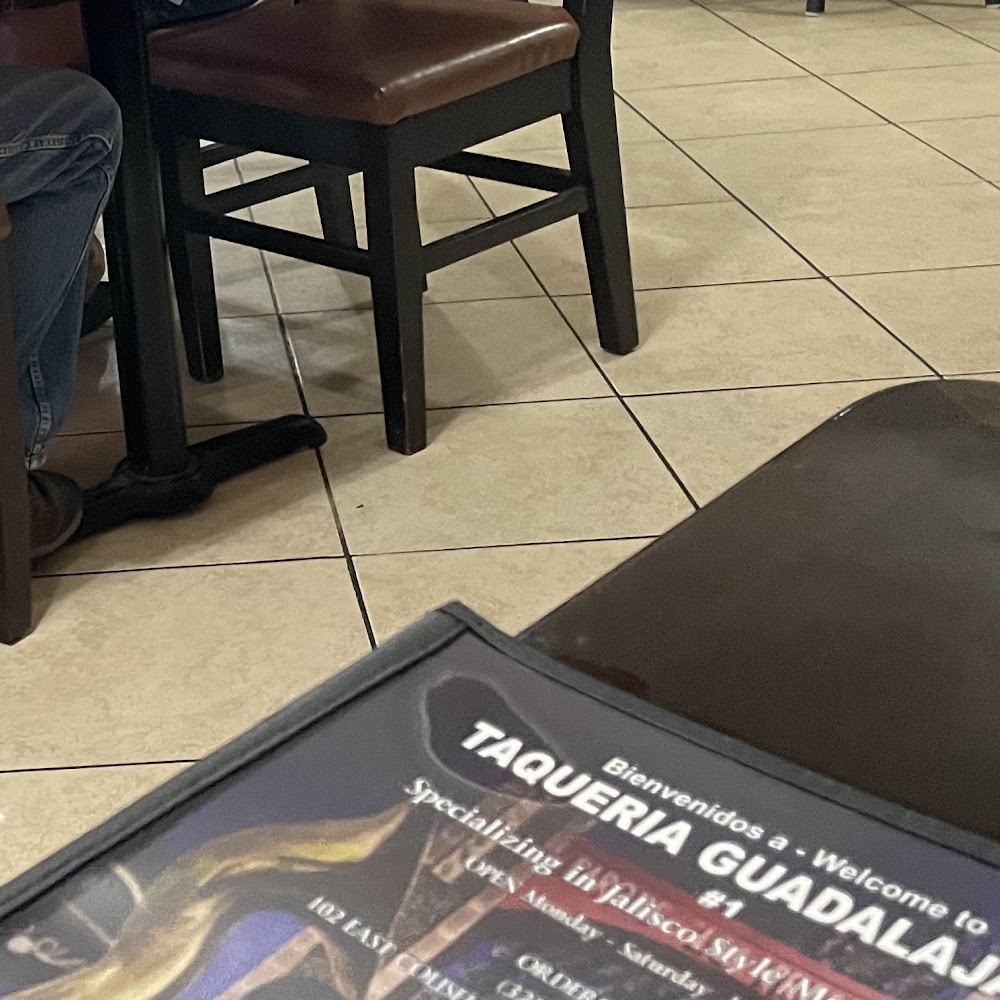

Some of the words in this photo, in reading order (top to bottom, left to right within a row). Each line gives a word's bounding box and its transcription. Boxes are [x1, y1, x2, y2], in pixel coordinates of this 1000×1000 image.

[461, 720, 692, 856] TAQUERIA
[602, 757, 764, 840] Bienvenidos
[768, 834, 789, 851] a
[812, 849, 949, 919] Welcome
[954, 910, 989, 935] to
[307, 896, 347, 925] 102
[341, 917, 398, 956] EAST
[404, 776, 562, 876] Specializing
[562, 864, 597, 893] in
[593, 884, 699, 943] Jalisco
[706, 937, 781, 984] Style
[465, 855, 517, 894] OPEN
[520, 889, 603, 942] Monday
[616, 941, 713, 998] Saturday
[700, 889, 744, 918] #1
[518, 954, 607, 1000] ORDER
